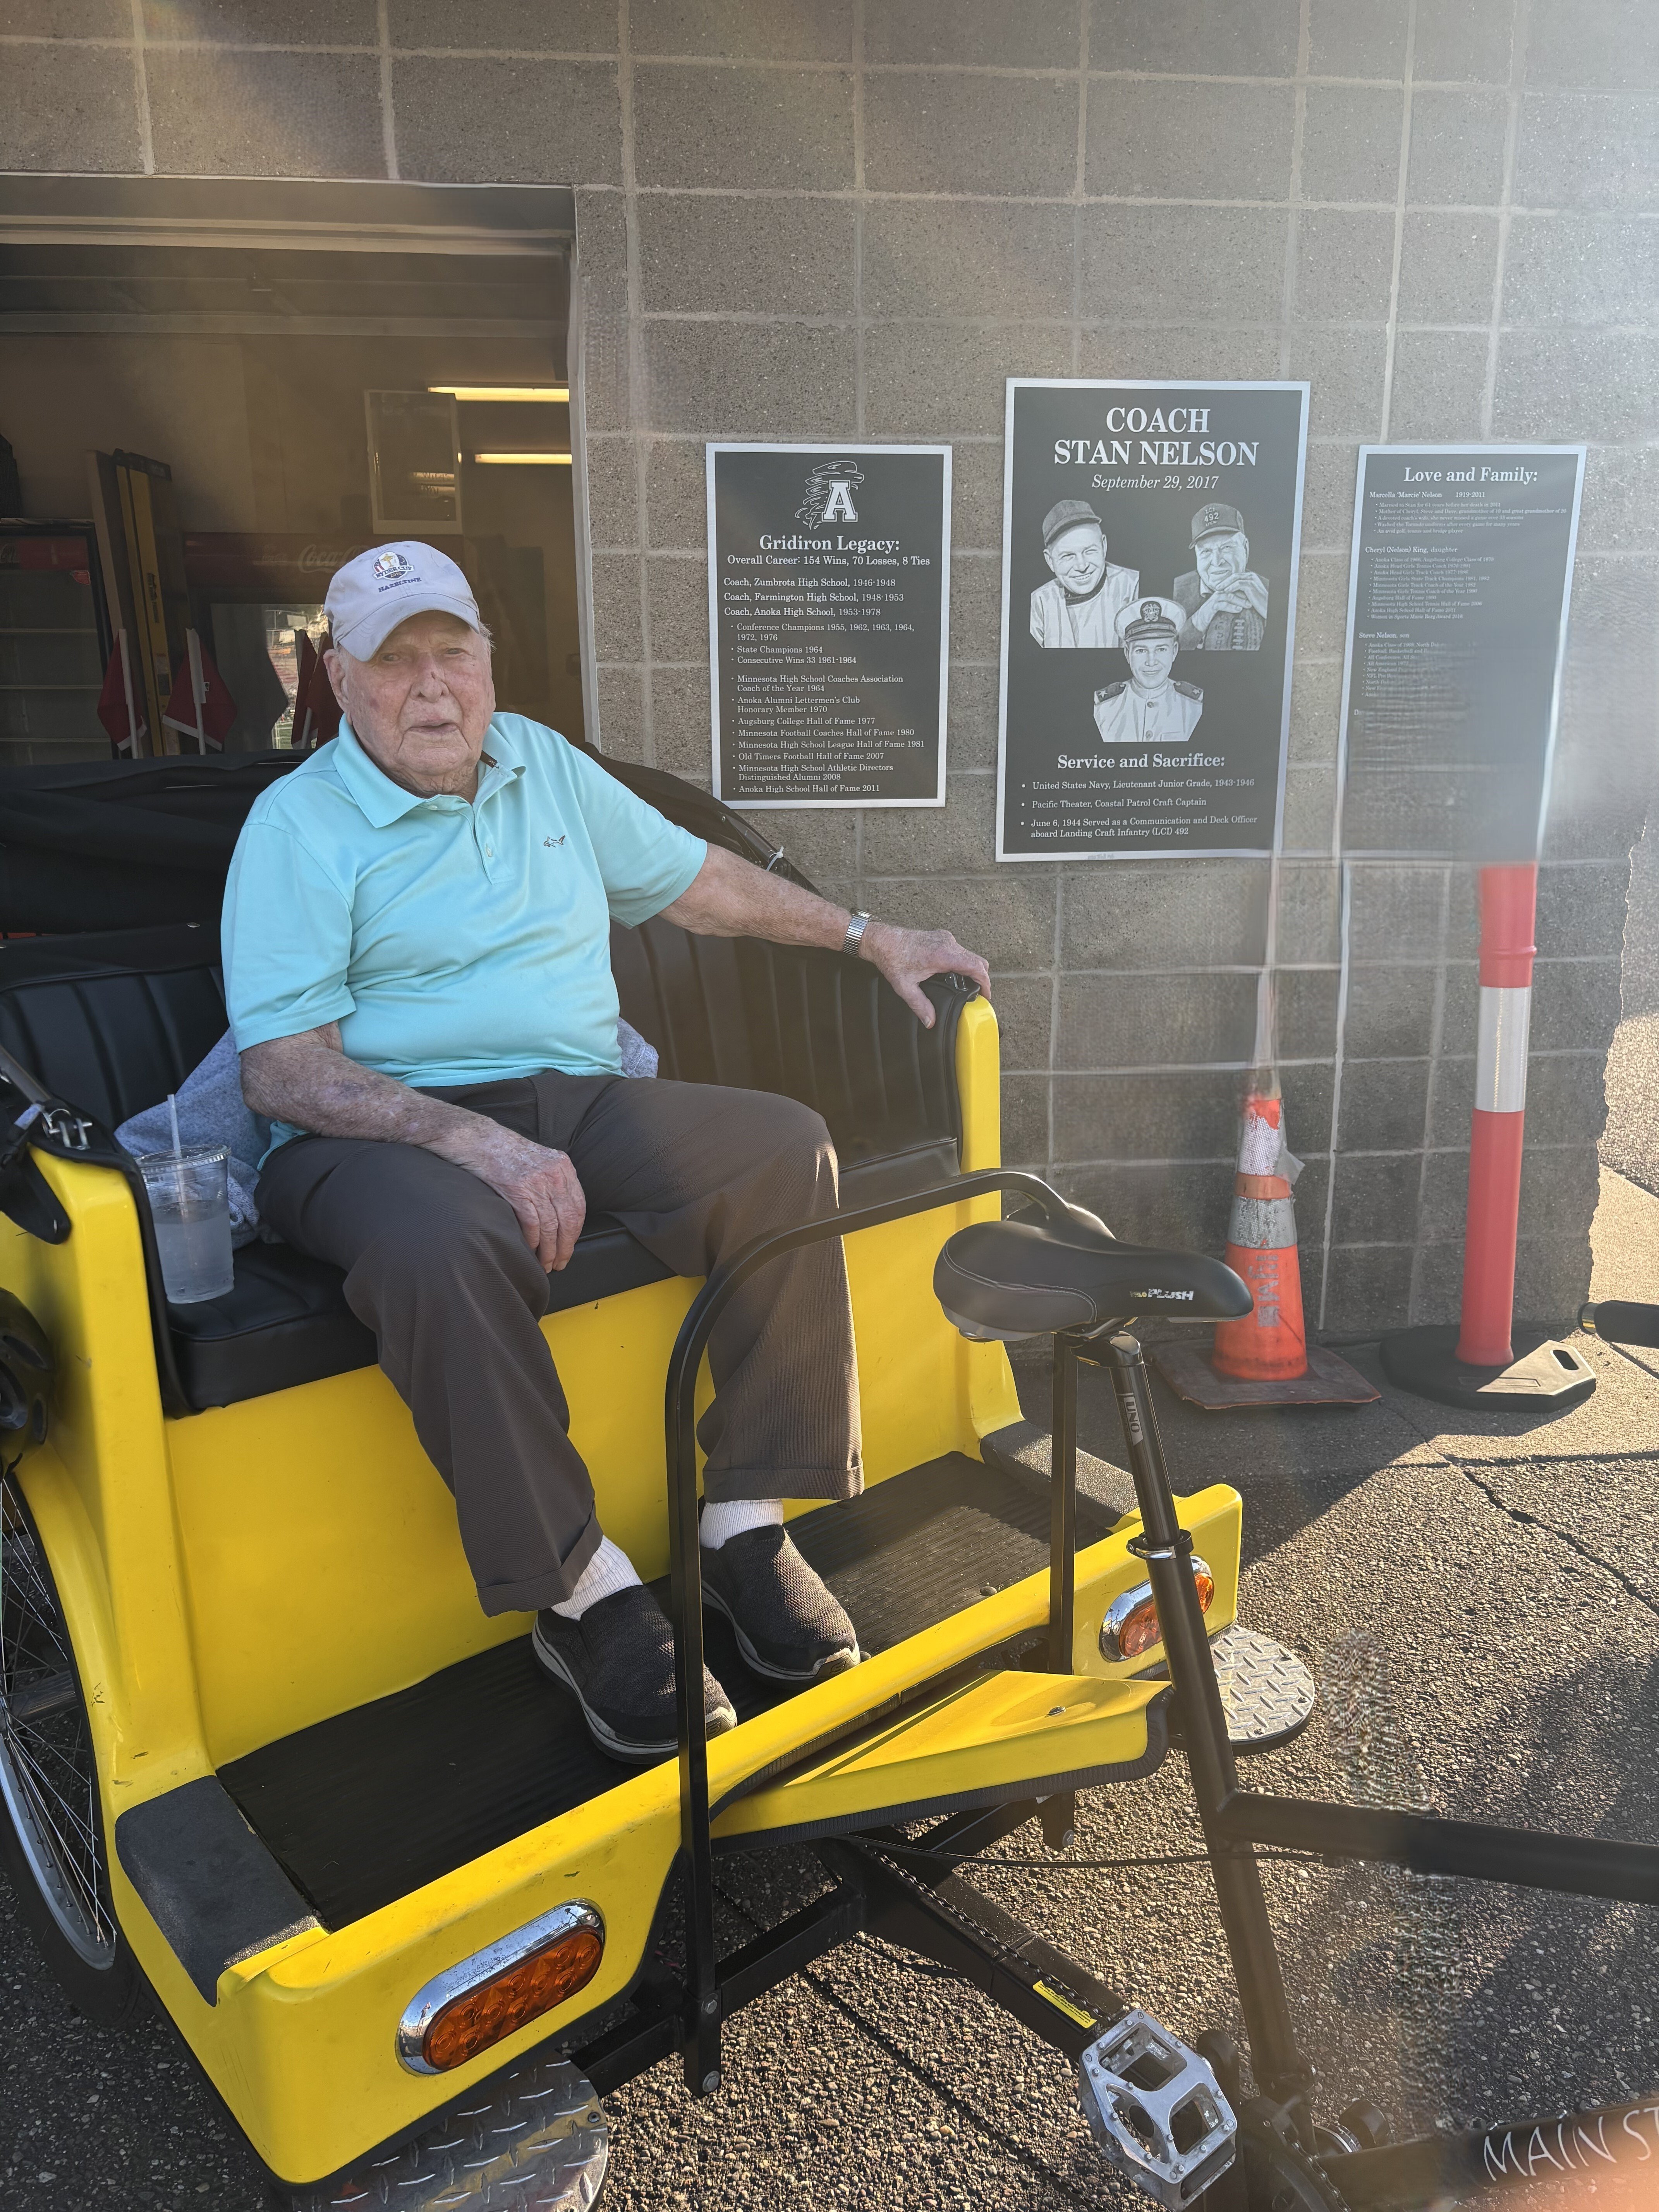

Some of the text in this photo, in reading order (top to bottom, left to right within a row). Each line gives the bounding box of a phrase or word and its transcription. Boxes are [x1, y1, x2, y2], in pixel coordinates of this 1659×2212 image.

[1106, 407, 1211, 433] COACH
[1054, 439, 1260, 466] STAN NELSON
[1403, 466, 1538, 485] Love and Family:
[1091, 474, 1219, 491] September 29, 2017
[821, 480, 858, 522] A
[1204, 512, 1219, 522] 492
[759, 534, 899, 554] Gridiron Legacy:
[1365, 546, 1385, 554] Cheryl
[727, 554, 930, 567] Overall Career: 154 Wins, 70 Losses, 8 Ties
[376, 567, 398, 578] RYDER
[378, 577, 422, 592] HAZELTINE
[723, 577, 896, 588] Coach, Zumbrota High School, 1946-1948
[723, 592, 904, 603] Coach, Farmington High School, 1948-1953
[724, 607, 881, 617] Coach, Anoka High School, 1953-1978
[781, 623, 824, 632] Champions
[827, 623, 847, 632] 1955,
[849, 623, 869, 632] 1962,
[872, 623, 892, 632] 1963,
[895, 623, 914, 632] 1964,
[737, 634, 757, 642] 1972,
[759, 645, 802, 654] Champions
[780, 675, 799, 685] High
[860, 674, 903, 682] Association
[842, 696, 860, 704] Club
[737, 705, 774, 713] Honorary
[737, 717, 775, 726] Augsburg
[776, 717, 804, 726] College
[780, 740, 799, 749] High
[827, 740, 855, 749] League
[1057, 752, 1225, 769] Service and Sacrifice:
[738, 773, 791, 782] Distinguished
[1032, 778, 1255, 790] United States Navy, Lieutenant Junior Grade, 1943-1946
[1032, 797, 1206, 809] Pacific Theater, Coastal Patrol Craft Captain
[1030, 819, 1051, 827] June
[1052, 819, 1060, 828] 6,
[1062, 818, 1080, 826] 1944
[1082, 817, 1109, 826] Served
[1129, 816, 1191, 825] Communication
[1192, 815, 1207, 824] and
[1209, 815, 1229, 824] Deck
[1231, 815, 1257, 823] Officer
[1030, 826, 1189, 838] aboard Landing Craft Infantry (LCI) 492
[1126, 1401, 1140, 1433] UNO
[1484, 2116, 1617, 2181] MAIN
